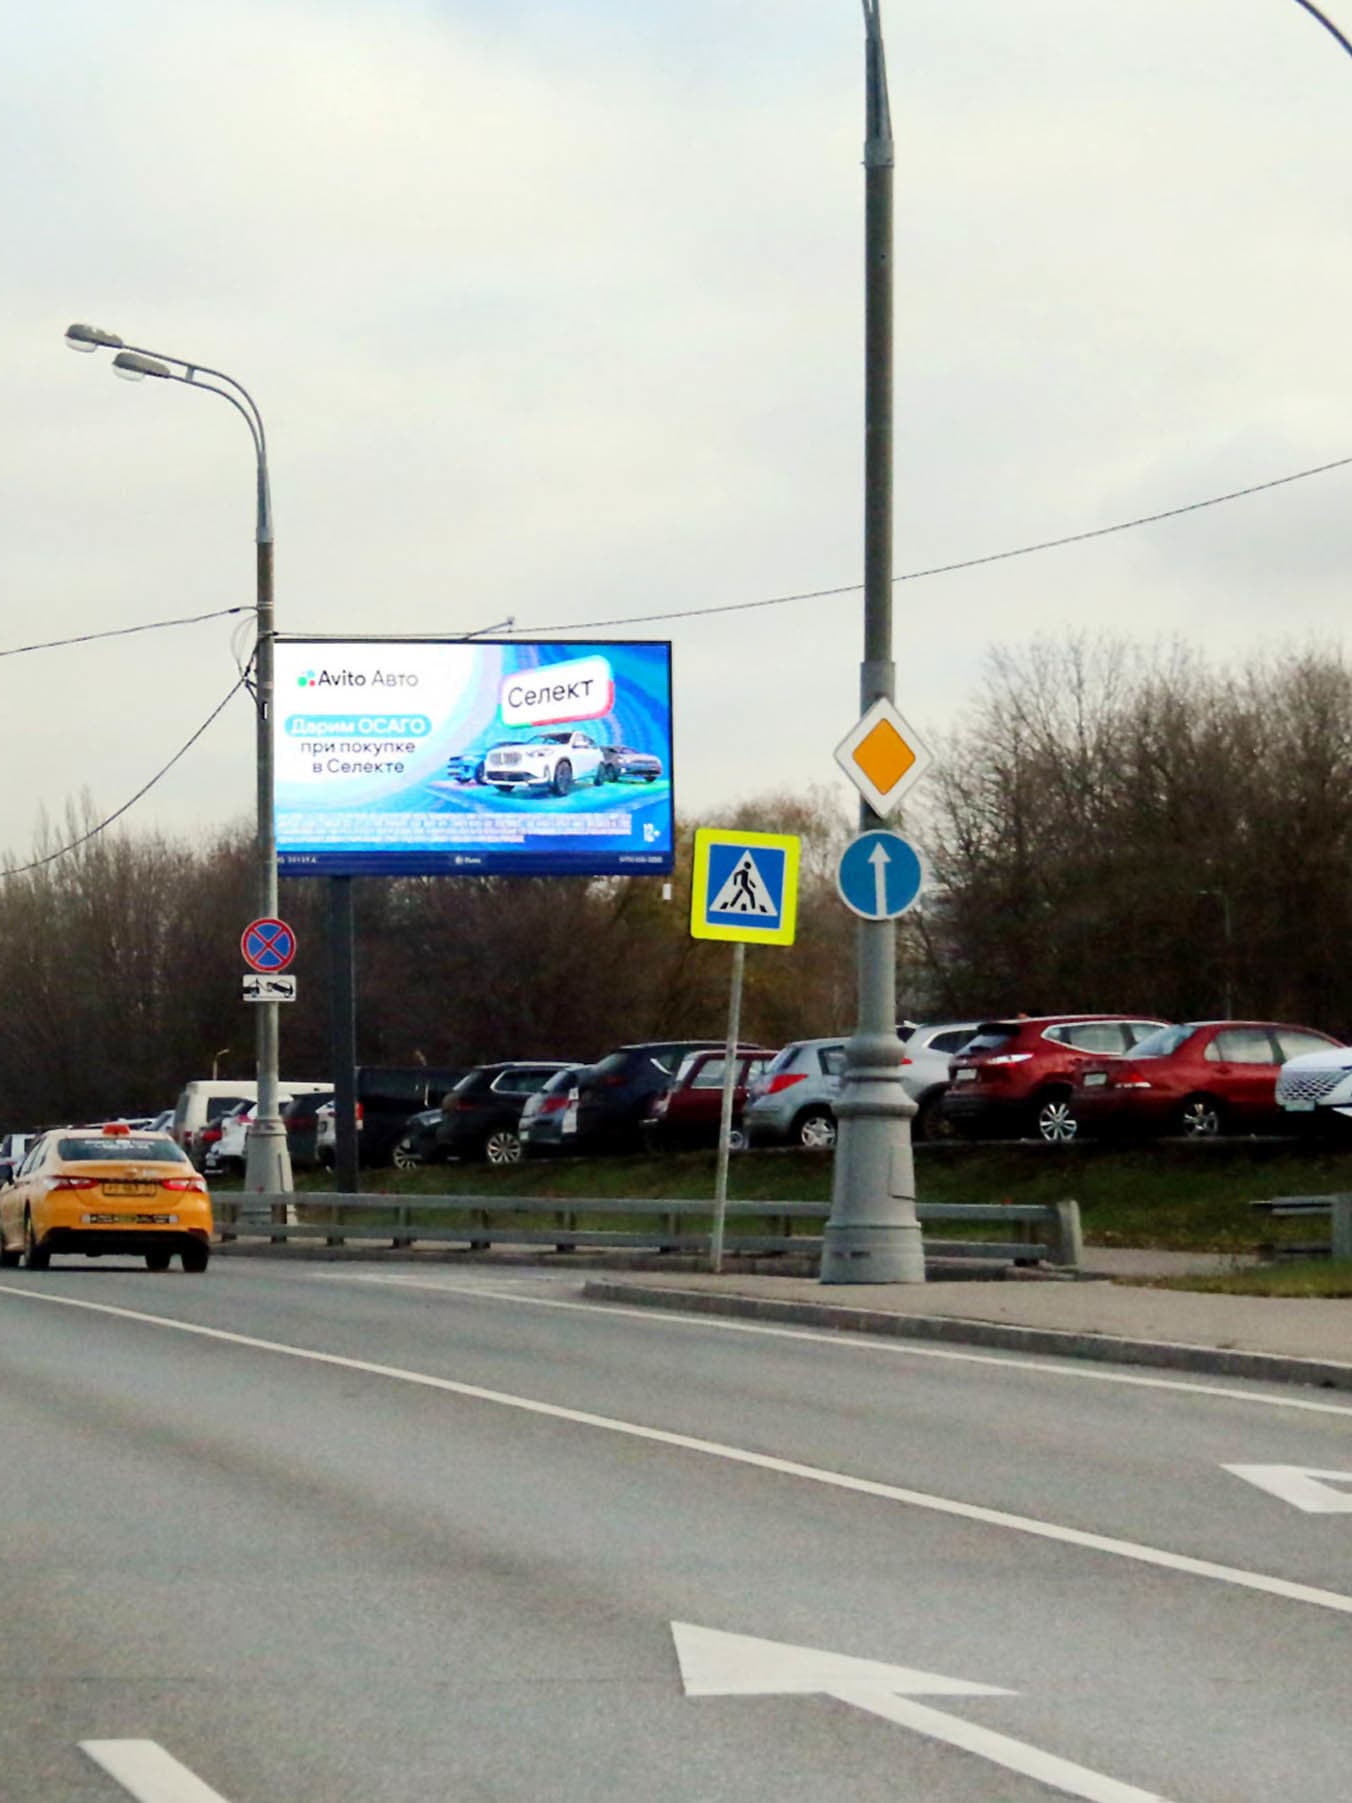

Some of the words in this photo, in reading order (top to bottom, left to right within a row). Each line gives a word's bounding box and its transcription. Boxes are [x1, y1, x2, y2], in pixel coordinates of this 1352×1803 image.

[318, 669, 366, 687] Avito
[371, 669, 419, 687] Авто
[508, 679, 594, 708] Селект
[291, 718, 355, 736] Дарим
[357, 717, 426, 735] ОСАГО
[301, 742, 336, 757] при
[339, 742, 416, 757] покупке
[312, 762, 323, 773] в
[326, 758, 405, 774] Селекте
